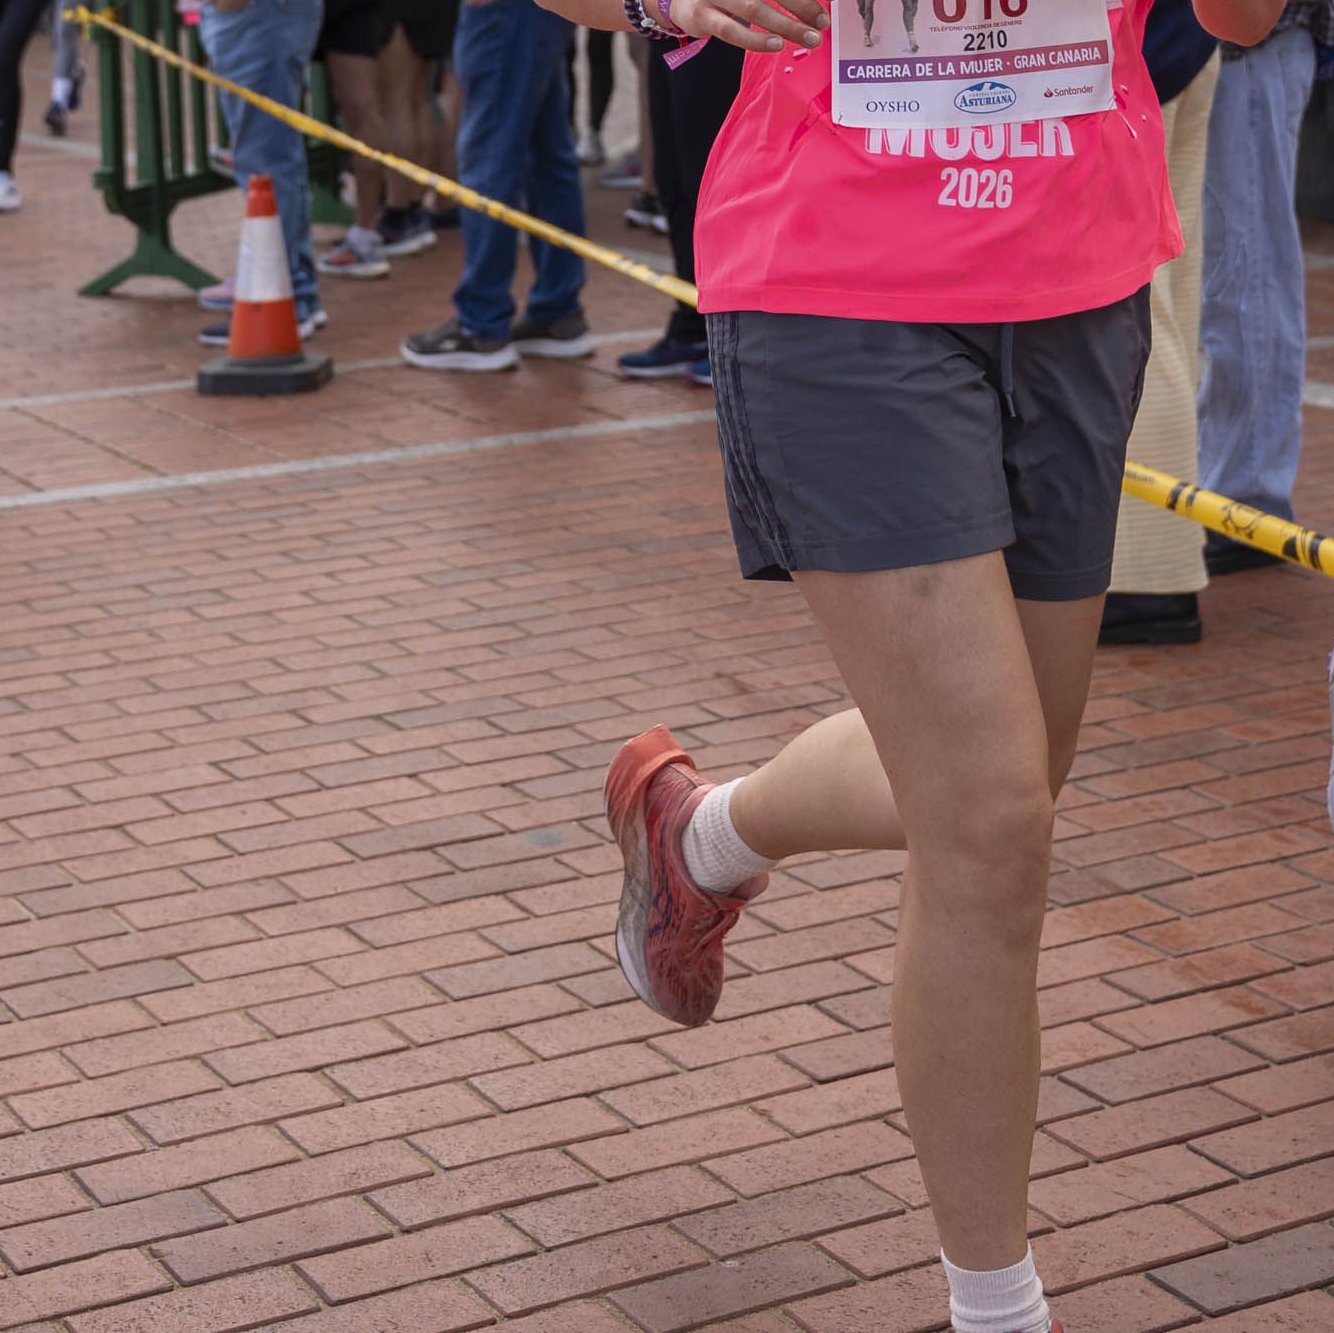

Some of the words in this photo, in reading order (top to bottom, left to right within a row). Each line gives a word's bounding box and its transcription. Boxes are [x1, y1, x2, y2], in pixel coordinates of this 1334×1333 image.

[963, 30, 1008, 52] 2210
[847, 63, 911, 79] CARRERA
[917, 62, 933, 77] DE
[938, 61, 955, 75] LA
[960, 57, 1003, 74] MUJER
[1014, 52, 1046, 69] GRAN
[1048, 46, 1101, 66] CANARIA
[1054, 85, 1094, 97] Santander
[866, 100, 920, 113] OYSHO
[959, 95, 1013, 107] ASTURIANA
[938, 167, 1013, 209] 2026
